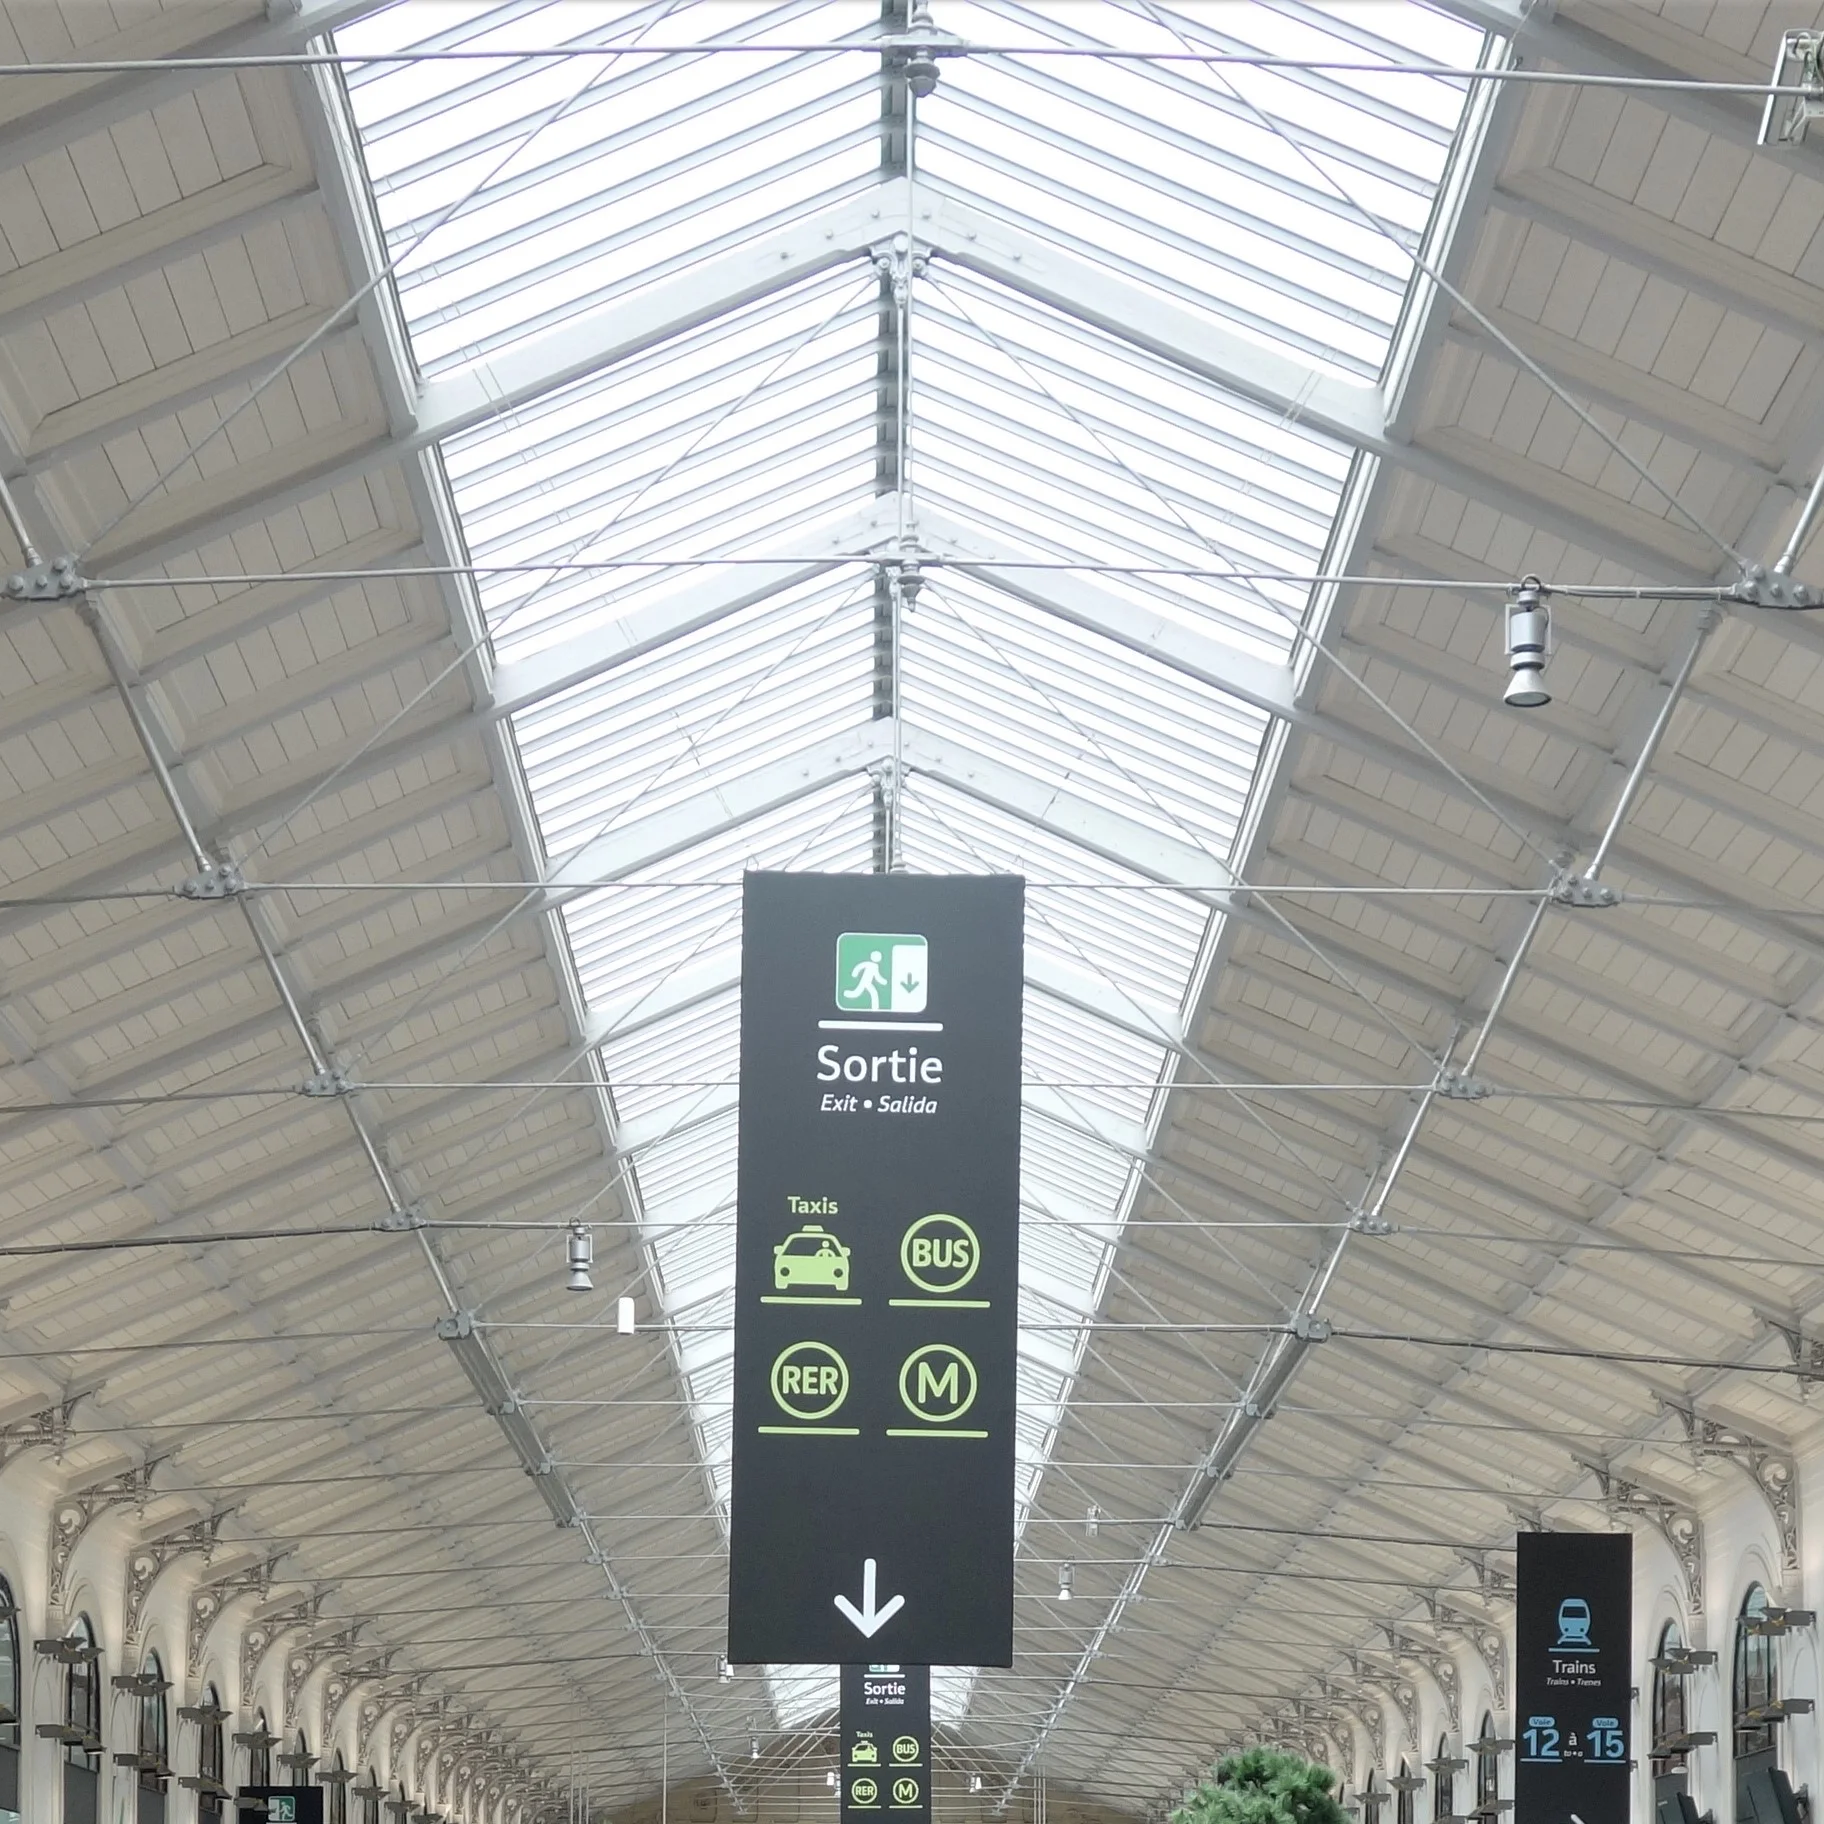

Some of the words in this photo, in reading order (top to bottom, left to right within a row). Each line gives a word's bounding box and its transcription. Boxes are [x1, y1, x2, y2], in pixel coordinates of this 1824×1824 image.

[817, 1045, 943, 1083] Sortie
[821, 1094, 858, 1112] Exit
[877, 1095, 938, 1114] Salida
[787, 1196, 839, 1215] Taxis
[912, 1238, 969, 1268] BUS
[782, 1365, 838, 1394] RER
[918, 1362, 958, 1404] M
[1552, 1660, 1596, 1674] Trains
[864, 1681, 906, 1695] Sortie
[1546, 1677, 1570, 1686] Trains
[1576, 1678, 1602, 1687] Trenes
[865, 1697, 879, 1705] Exit
[896, 1744, 916, 1755] BUS
[1522, 1728, 1560, 1757] 12
[1568, 1732, 1577, 1746] à
[1586, 1729, 1625, 1758] 15
[855, 1785, 874, 1796] RER
[898, 1783, 913, 1799] M
